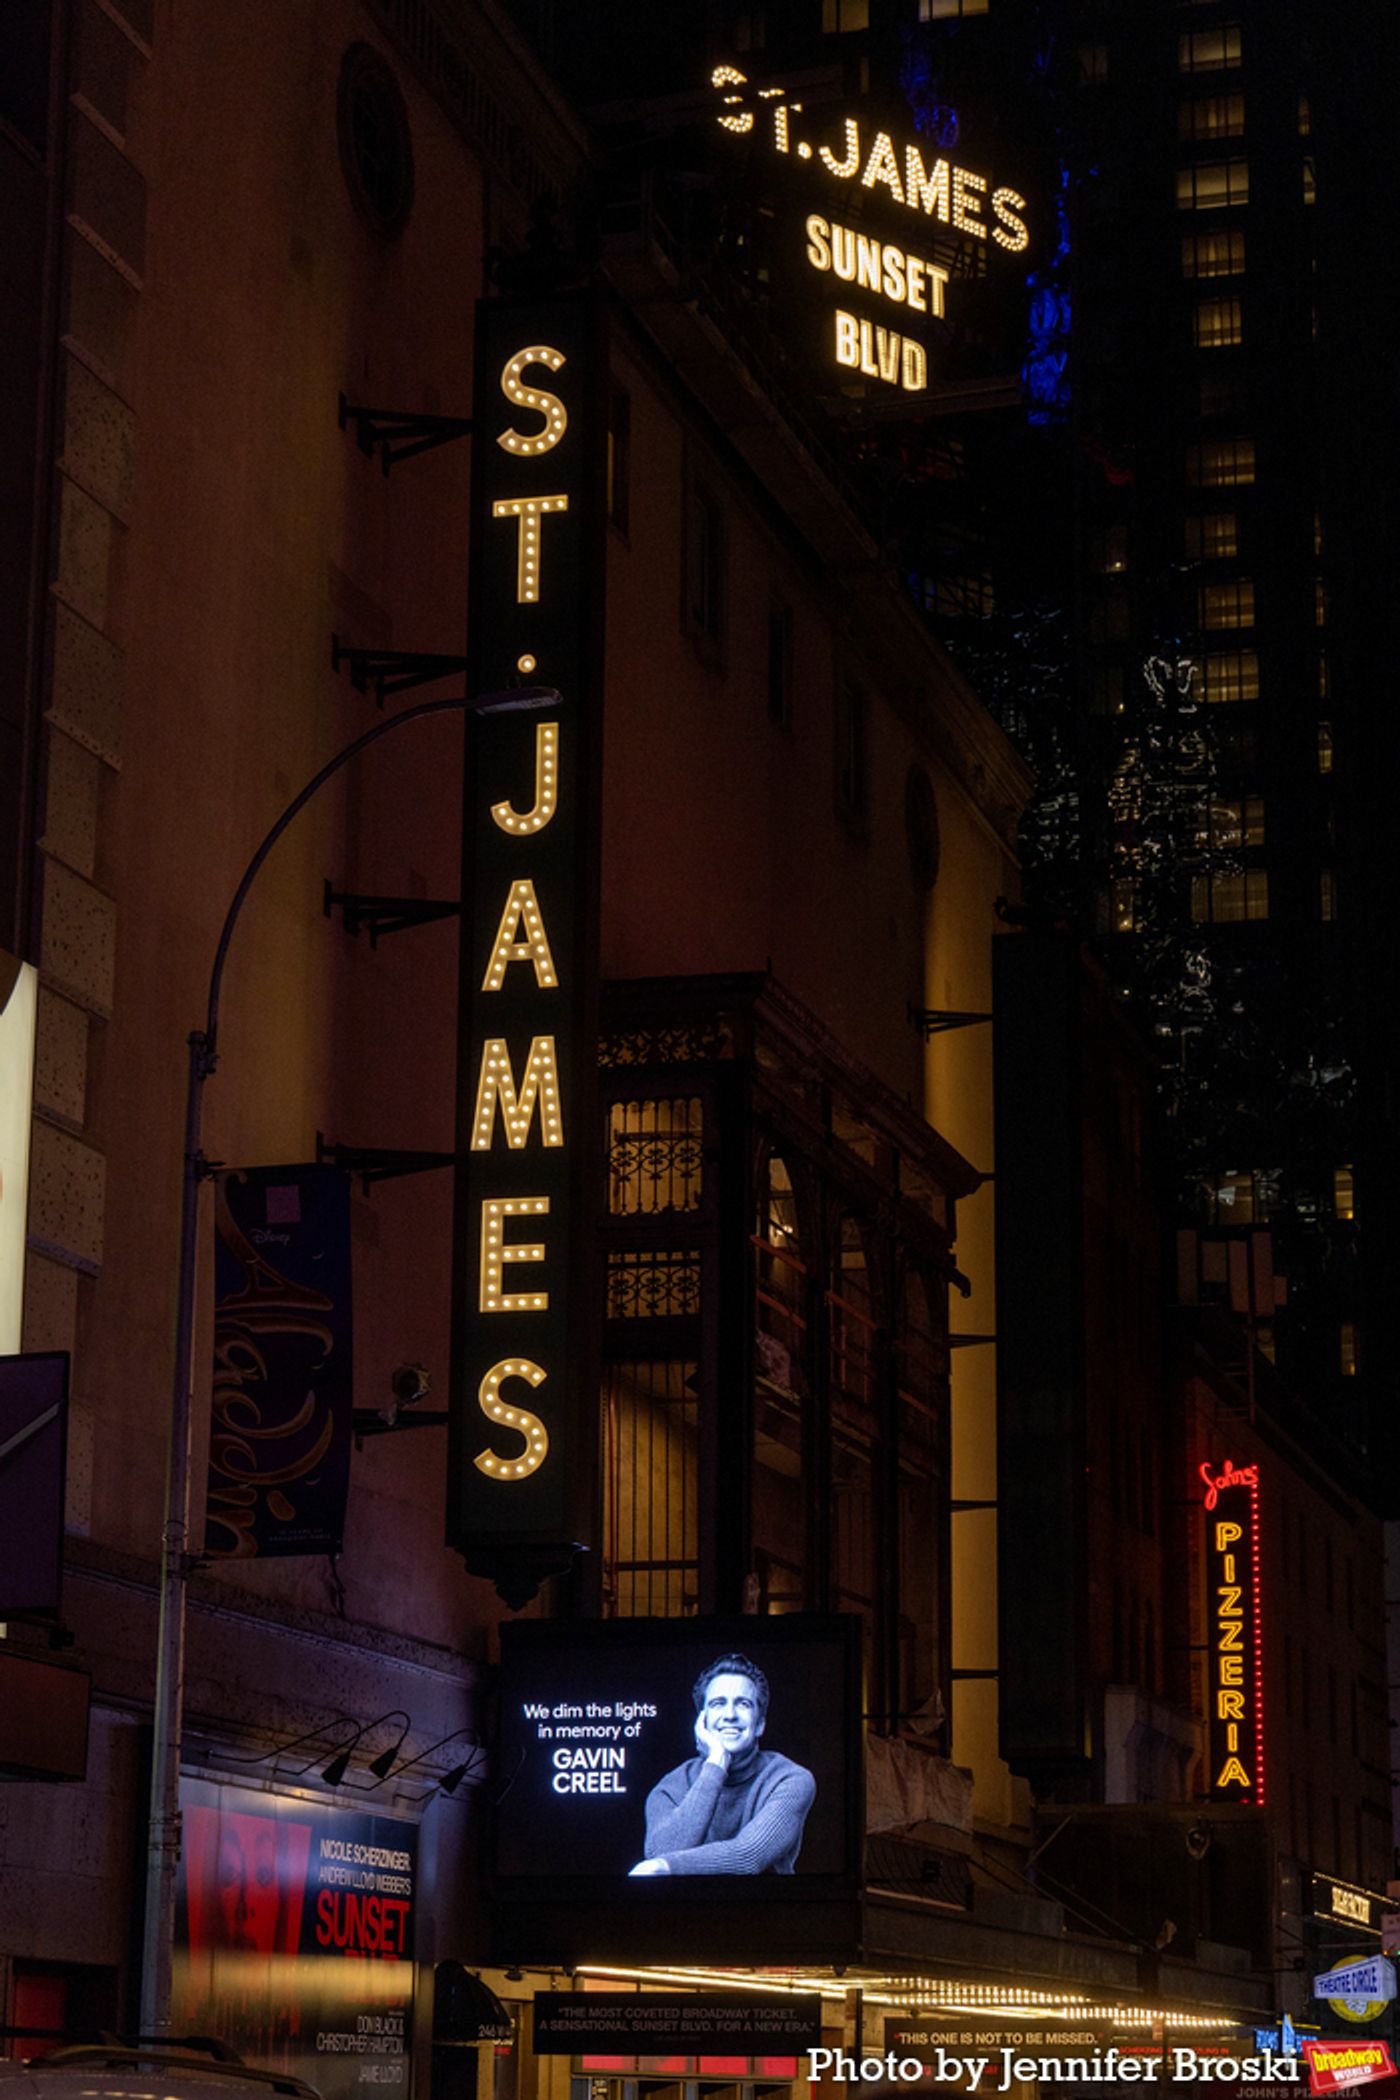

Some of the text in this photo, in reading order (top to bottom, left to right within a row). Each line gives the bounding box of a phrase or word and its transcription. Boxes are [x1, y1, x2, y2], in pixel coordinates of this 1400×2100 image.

[711, 65, 1030, 253] ST. JAMES
[805, 213, 949, 319] SUNSET
[835, 308, 928, 391] BLVD
[470, 722, 564, 1482] JAMES
[1215, 1521, 1251, 1787] PIZZERIA
[523, 1701, 657, 1722] We dim the lights
[538, 1722, 642, 1741] in memory of
[553, 1747, 626, 1770] GAVIN
[553, 1771, 627, 1794] CREEL
[320, 1838, 352, 1862] NICOLE
[315, 1887, 411, 1953] SUNSET
[589, 2007, 622, 2019] MOST
[624, 2007, 680, 2019] COVETED
[682, 2007, 751, 2020] BROADWAY
[752, 2007, 798, 2020] TICKET.
[539, 2019, 548, 2031] A
[550, 2019, 630, 2032] SENSATIONAL
[632, 2019, 678, 2032] SUNSET
[681, 2019, 714, 2032] BLVD.
[716, 2020, 740, 2032] FOR
[742, 2020, 753, 2032] A
[754, 2020, 783, 2032] NEW
[930, 2031, 958, 2045] ONE
[960, 2031, 973, 2045] IS
[975, 2031, 1002, 2045] NOT
[1004, 2031, 1023, 2045] TO
[1025, 2031, 1047, 2045] BE
[1236, 2087, 1290, 2099] JOHN'S
